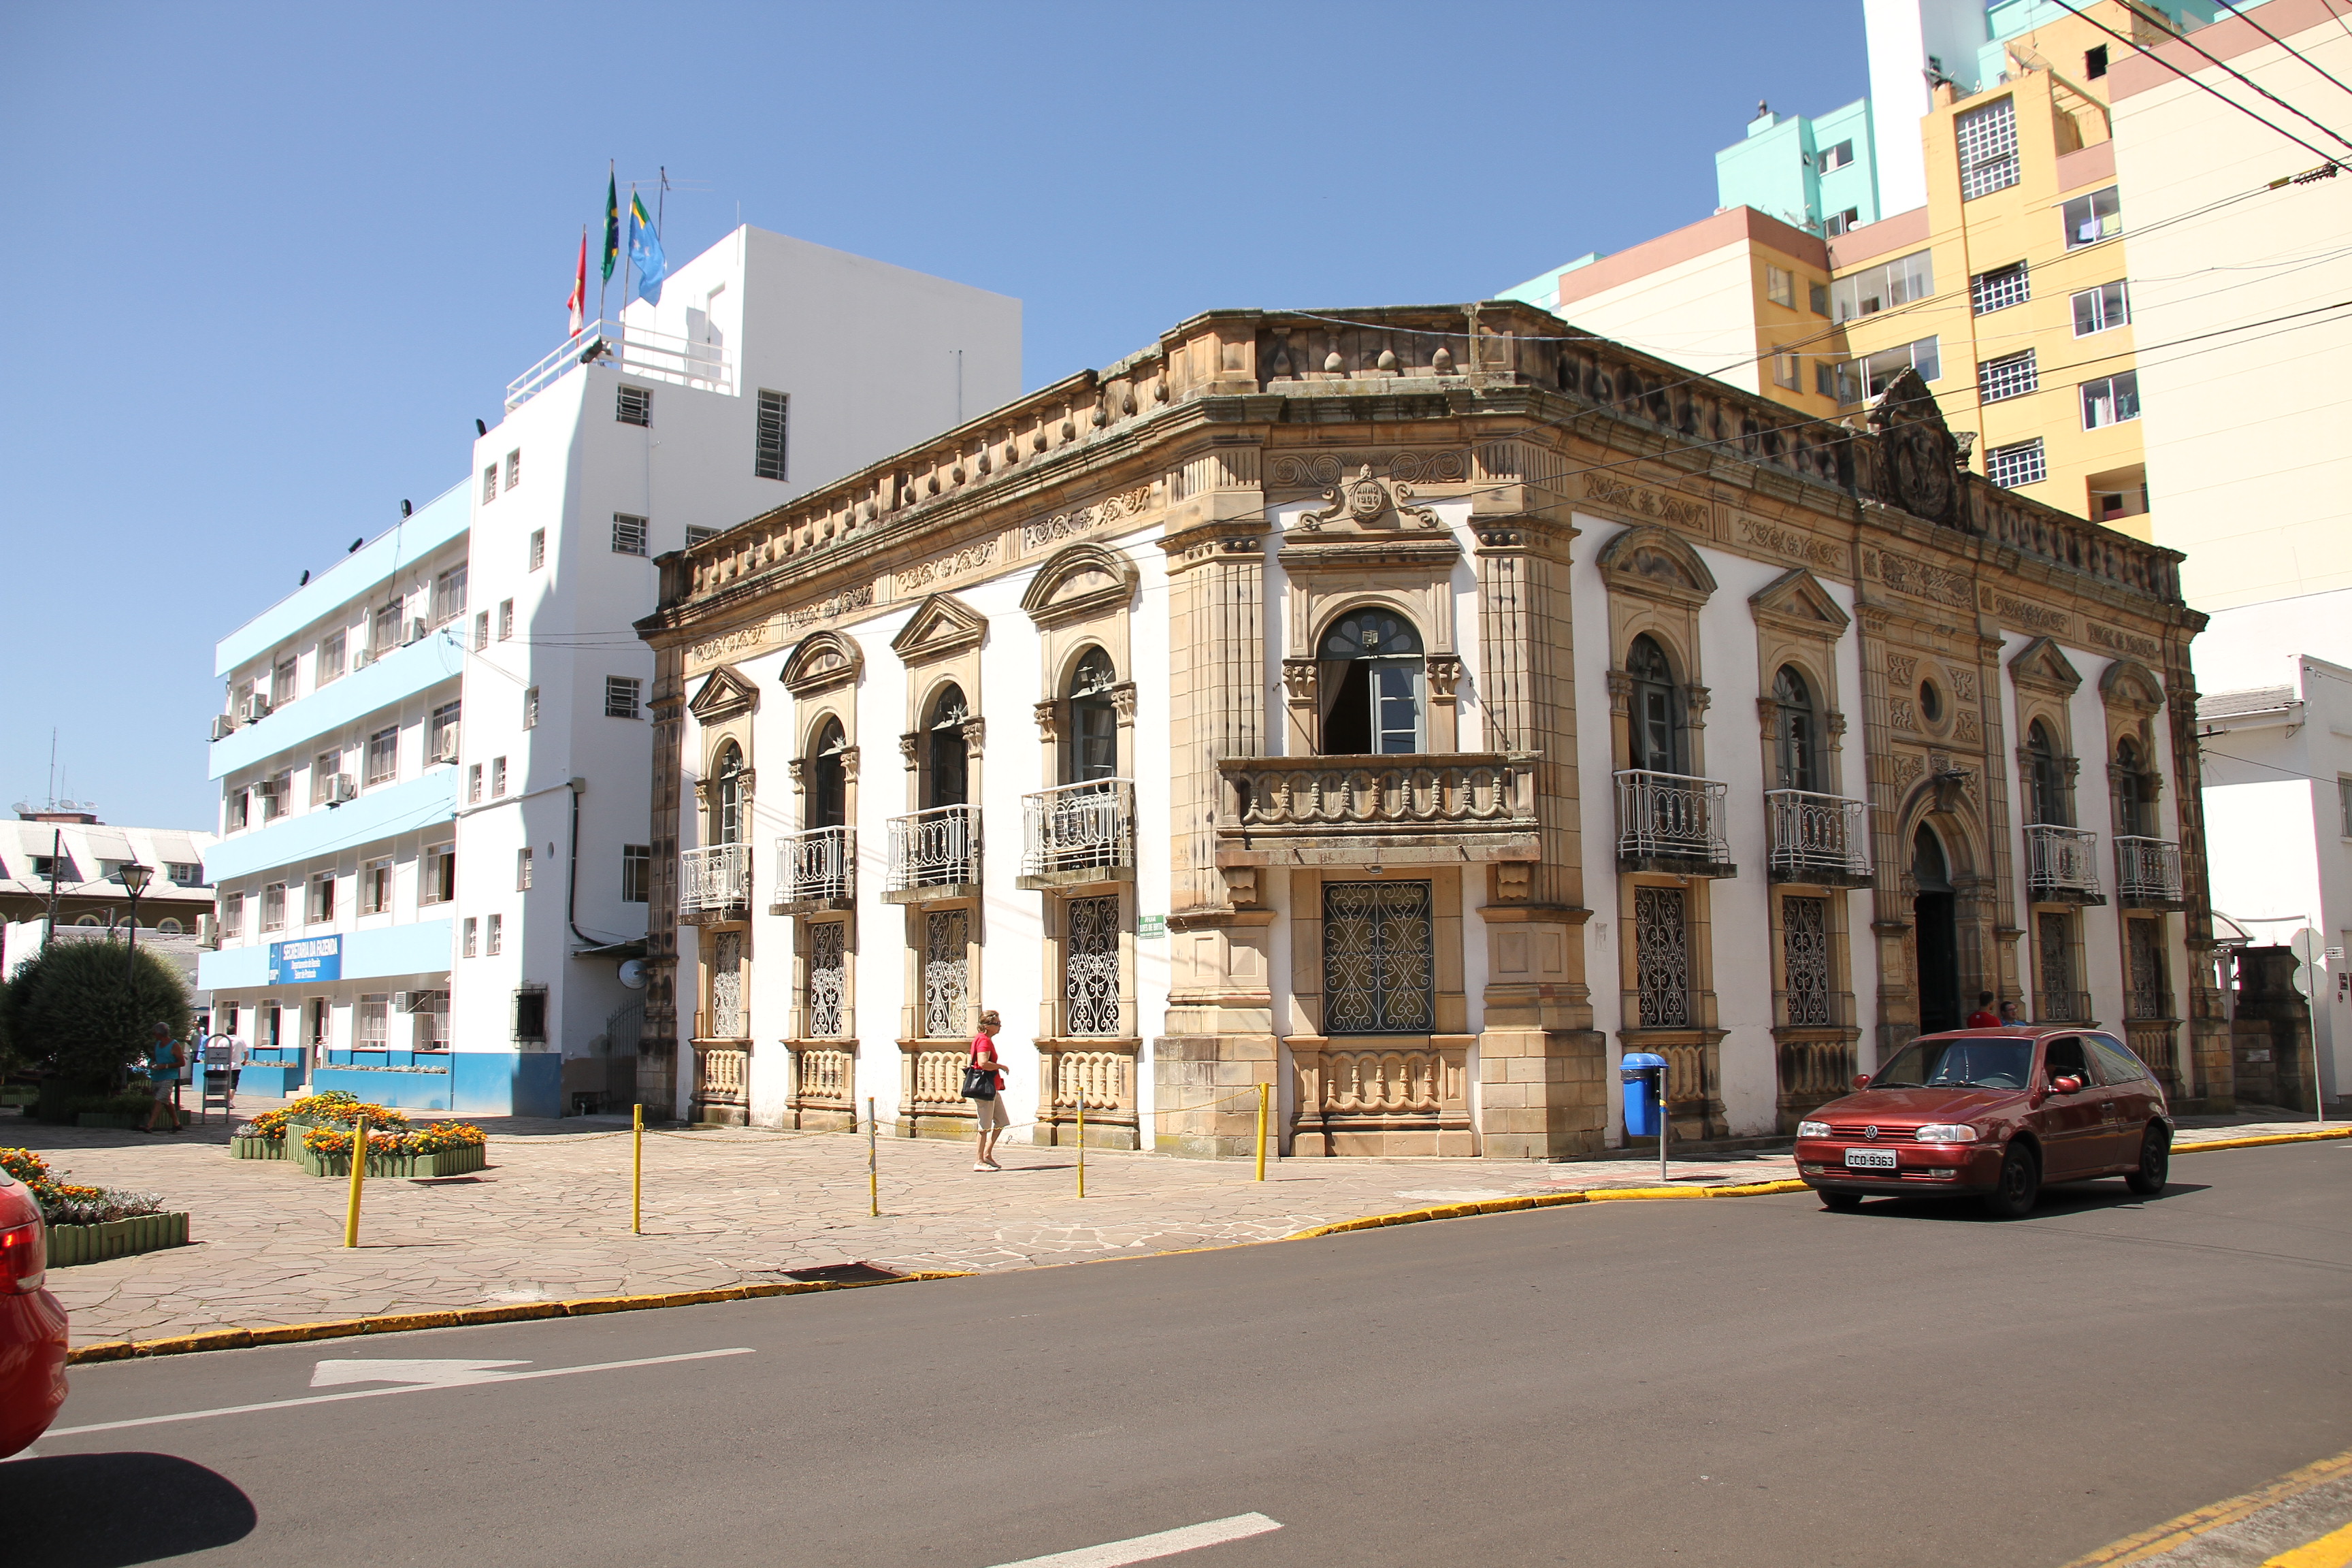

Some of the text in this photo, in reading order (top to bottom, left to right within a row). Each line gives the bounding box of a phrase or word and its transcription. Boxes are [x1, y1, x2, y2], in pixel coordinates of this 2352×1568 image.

[1357, 486, 1378, 495] ANNO
[1356, 495, 1378, 504] 1900
[1148, 923, 1153, 931] DE
[1154, 922, 1163, 930] BRITO
[283, 938, 338, 960] SECRETARIA DA FAZENDA
